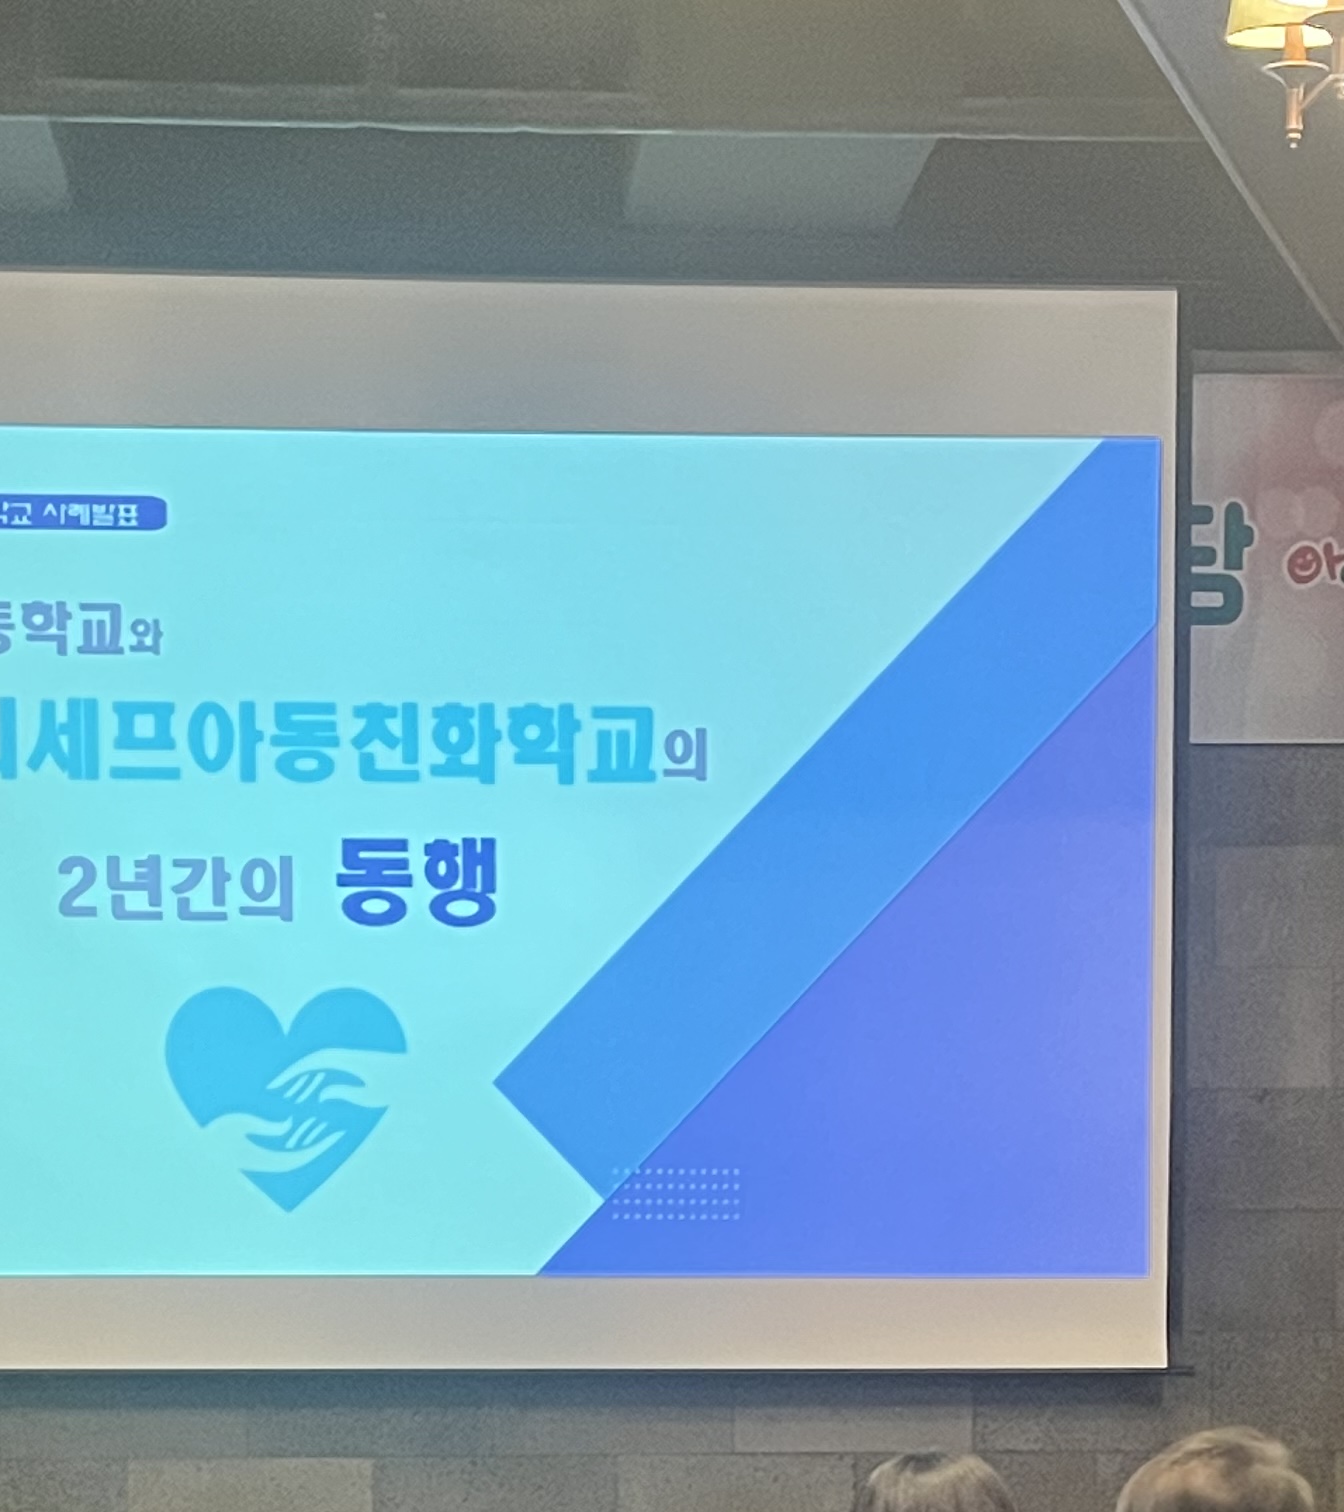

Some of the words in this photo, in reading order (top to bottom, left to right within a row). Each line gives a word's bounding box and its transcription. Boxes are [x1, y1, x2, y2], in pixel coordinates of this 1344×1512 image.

[42, 502, 139, 527] 사례발표
[58, 854, 294, 923] 2년간의
[335, 836, 497, 928] 동행
